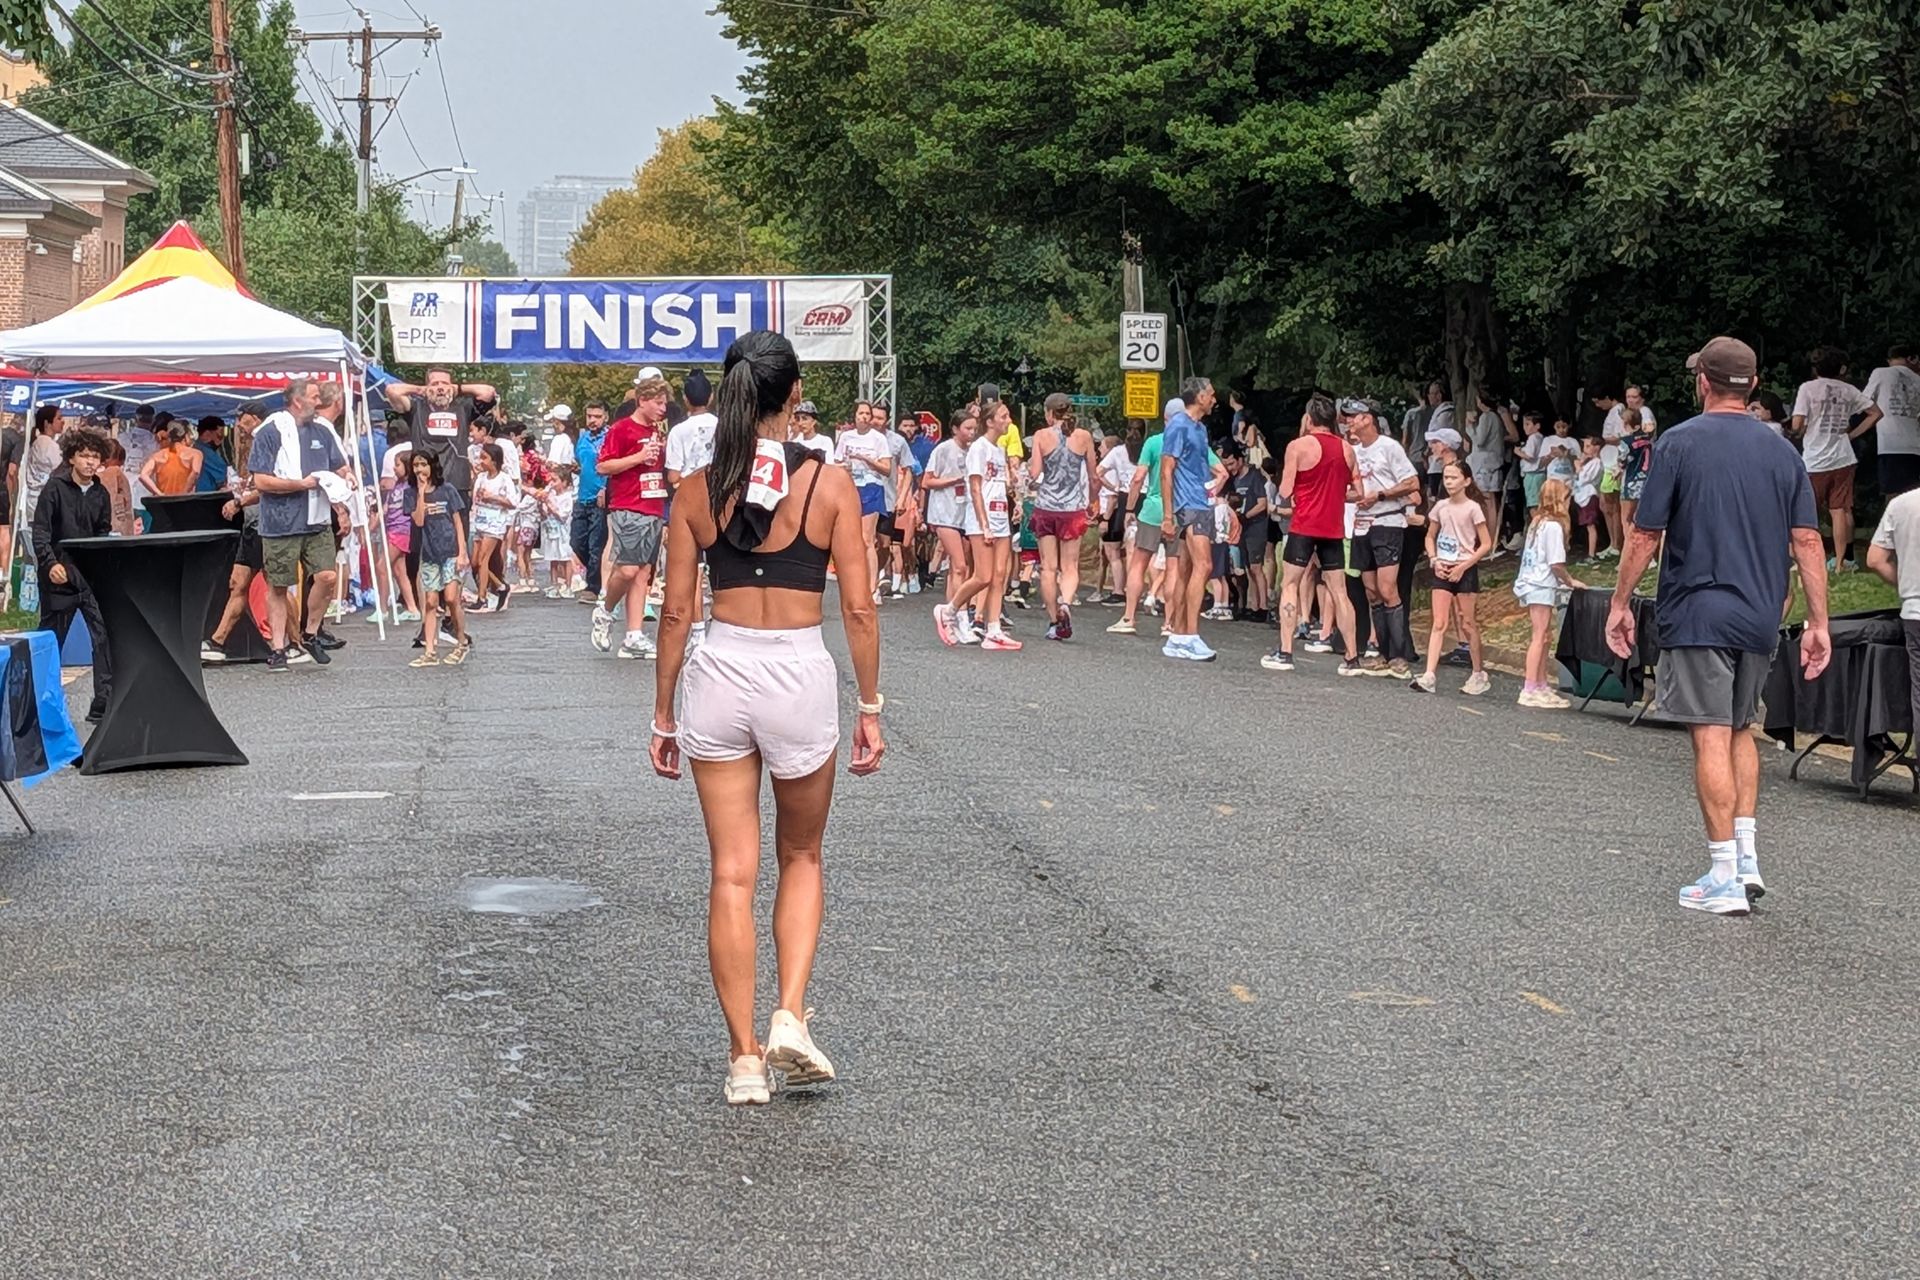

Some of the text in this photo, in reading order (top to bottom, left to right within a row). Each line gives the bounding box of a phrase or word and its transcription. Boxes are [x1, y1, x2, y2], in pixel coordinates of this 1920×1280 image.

[495, 293, 751, 350] FINISH
[1126, 319, 1163, 329] SPEED
[1129, 331, 1157, 340] LIMIT
[1126, 342, 1160, 362] 20
